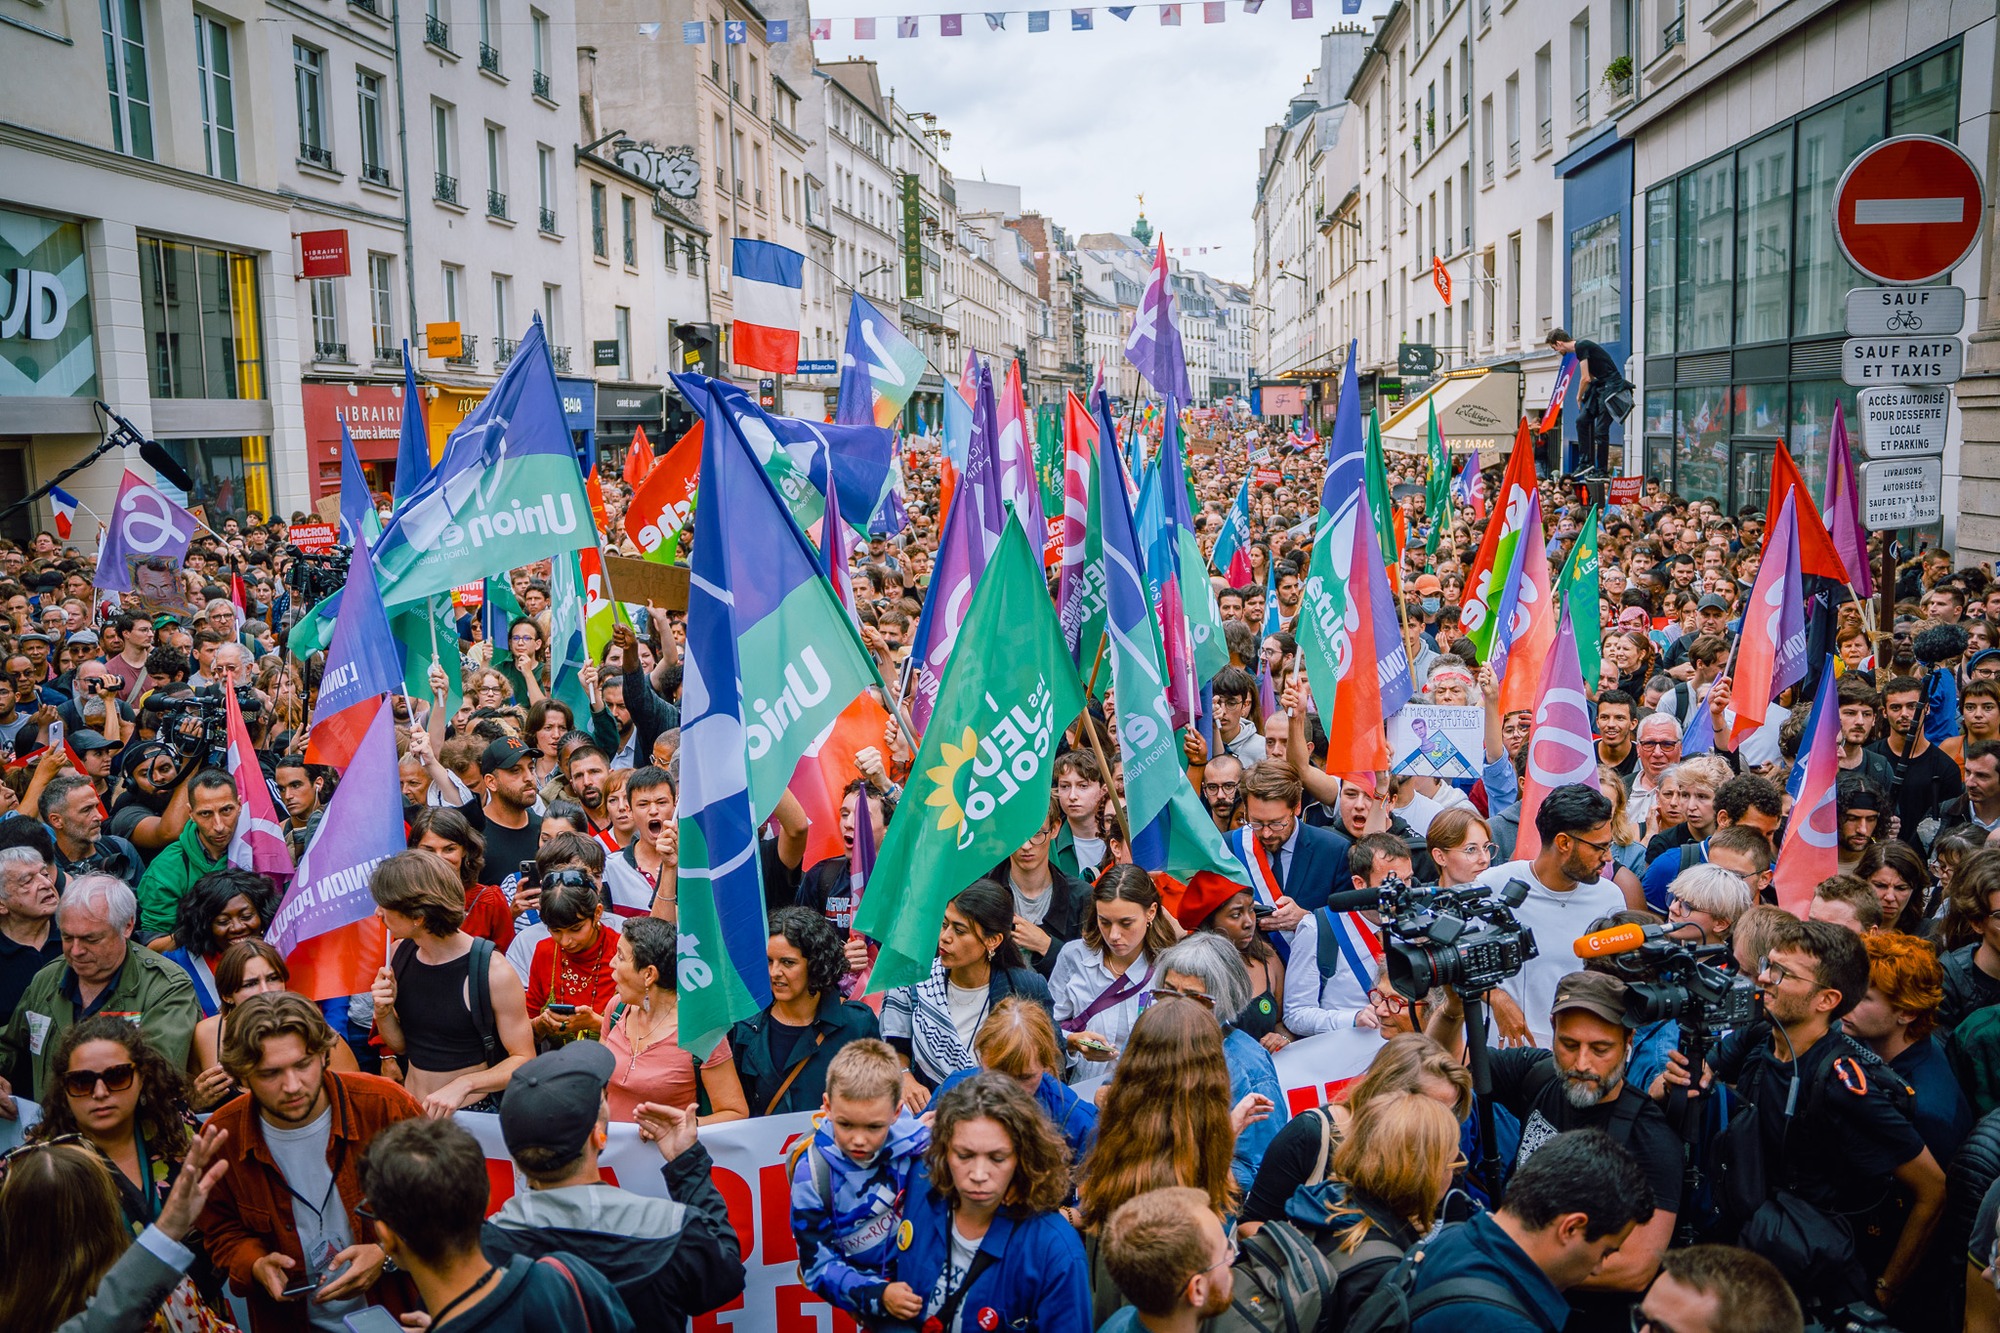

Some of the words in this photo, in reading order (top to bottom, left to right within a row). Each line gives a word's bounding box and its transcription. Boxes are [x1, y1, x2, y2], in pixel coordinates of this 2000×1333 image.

[304, 248, 342, 256] LIBRAIRIE
[1882, 292, 1930, 306] SAUF
[1854, 346, 1901, 359] SAUF
[1908, 344, 1953, 358] RATP
[797, 362, 810, 371] oule
[811, 361, 835, 371] Blanche
[1863, 365, 1883, 378] ET
[1892, 363, 1942, 377] TAXIS
[761, 380, 772, 388] 76
[629, 400, 641, 408] BLANC
[762, 396, 772, 405] 86
[1868, 392, 1899, 406] ACCÈS
[1900, 391, 1945, 405] AUTORISÉ
[336, 406, 404, 422] LIBRAIRI
[1870, 410, 1895, 421] POUR
[1896, 408, 1941, 420] DESSERTE
[1889, 425, 1921, 436] LOCALE
[1465, 439, 1495, 449] TABAC
[1880, 441, 1891, 451] ET
[1893, 438, 1929, 450] PARKING
[1884, 467, 1922, 478] LIVRAISONS
[1882, 480, 1922, 492] AUTORISÉES
[1869, 499, 1886, 508] SAUF
[1887, 498, 1897, 506] DE
[1870, 514, 1878, 522] ET
[1880, 512, 1888, 521] DE
[291, 526, 333, 538] MACRON,
[292, 537, 331, 546] DESTITUTION
[1581, 557, 1598, 574] LES
[1410, 707, 1439, 719] MACRON,
[1440, 708, 1452, 718] POUR
[1463, 710, 1479, 719] C'EST
[1428, 719, 1475, 728] DESTITUTION
[826, 896, 851, 912] NEW-
[842, 1238, 864, 1250] TAX
[873, 1211, 898, 1238] RICH
